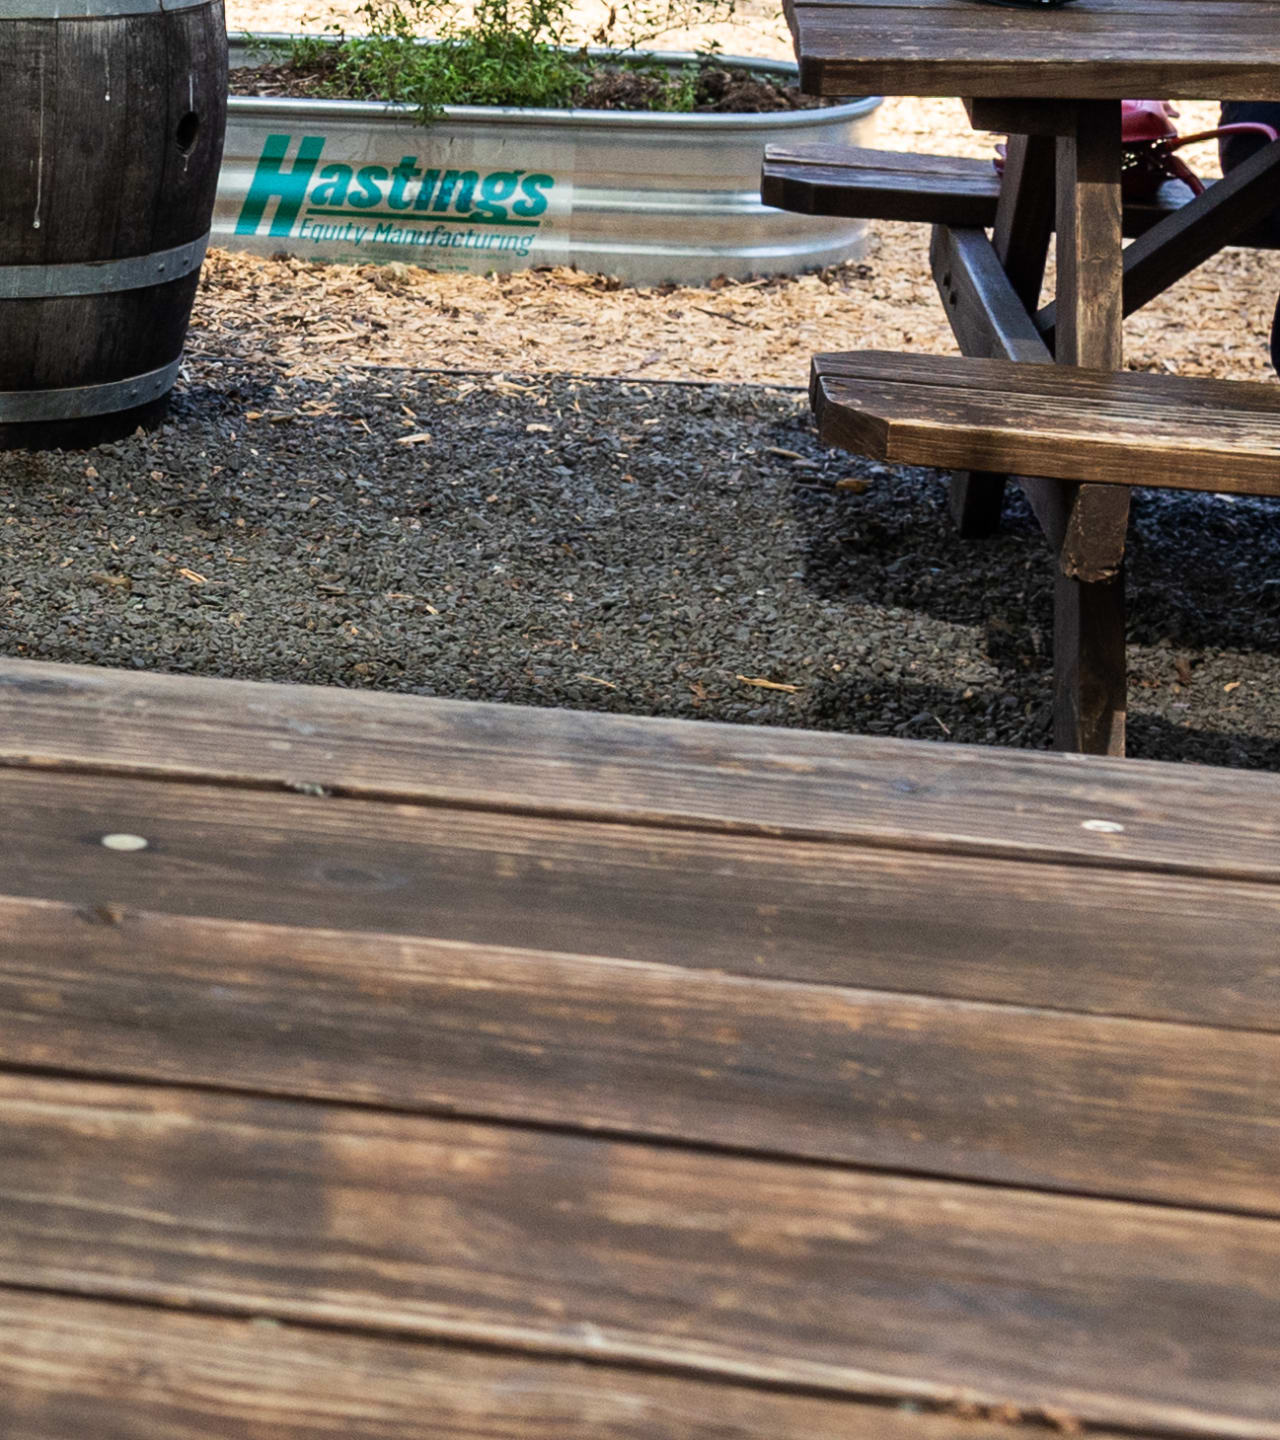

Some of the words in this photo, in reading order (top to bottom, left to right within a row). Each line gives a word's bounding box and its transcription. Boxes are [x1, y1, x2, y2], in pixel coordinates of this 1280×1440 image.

[234, 134, 555, 236] Hastings
[298, 218, 366, 246] Equity
[374, 222, 535, 257] Manufacturing
